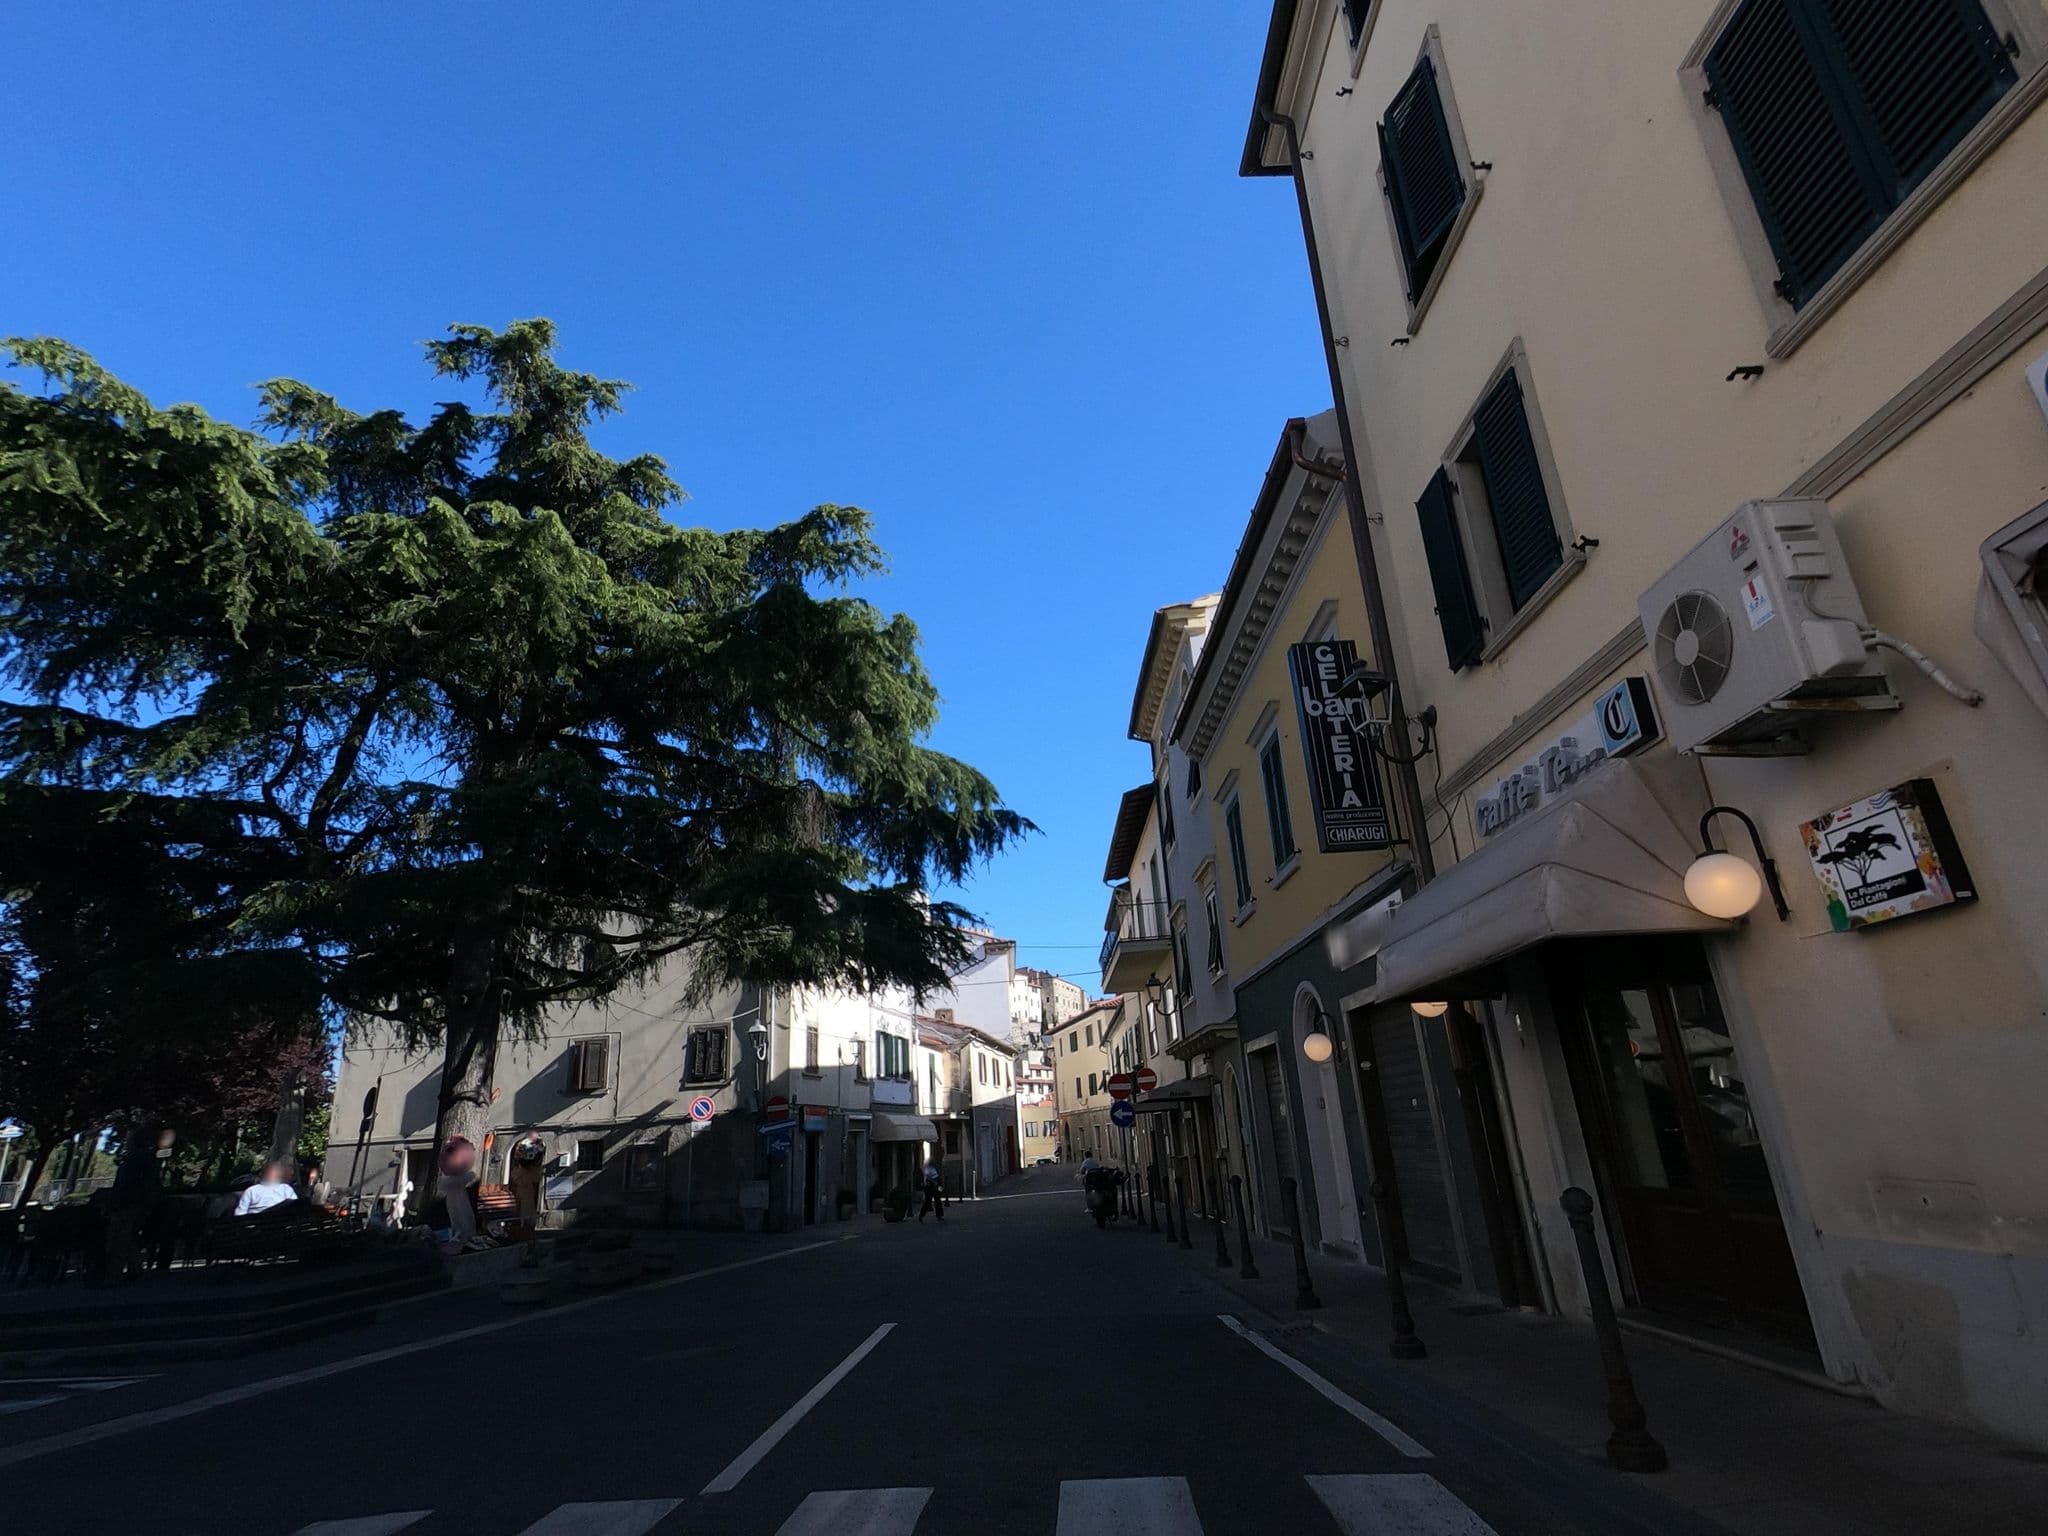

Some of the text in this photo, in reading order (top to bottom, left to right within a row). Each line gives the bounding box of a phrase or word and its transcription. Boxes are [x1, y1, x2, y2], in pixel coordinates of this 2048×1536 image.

[1302, 686, 1364, 717] bar
[1329, 826, 1385, 841] CHIARUGI
[1847, 891, 1858, 899] Le
[1850, 891, 1888, 908] Del Caffè
